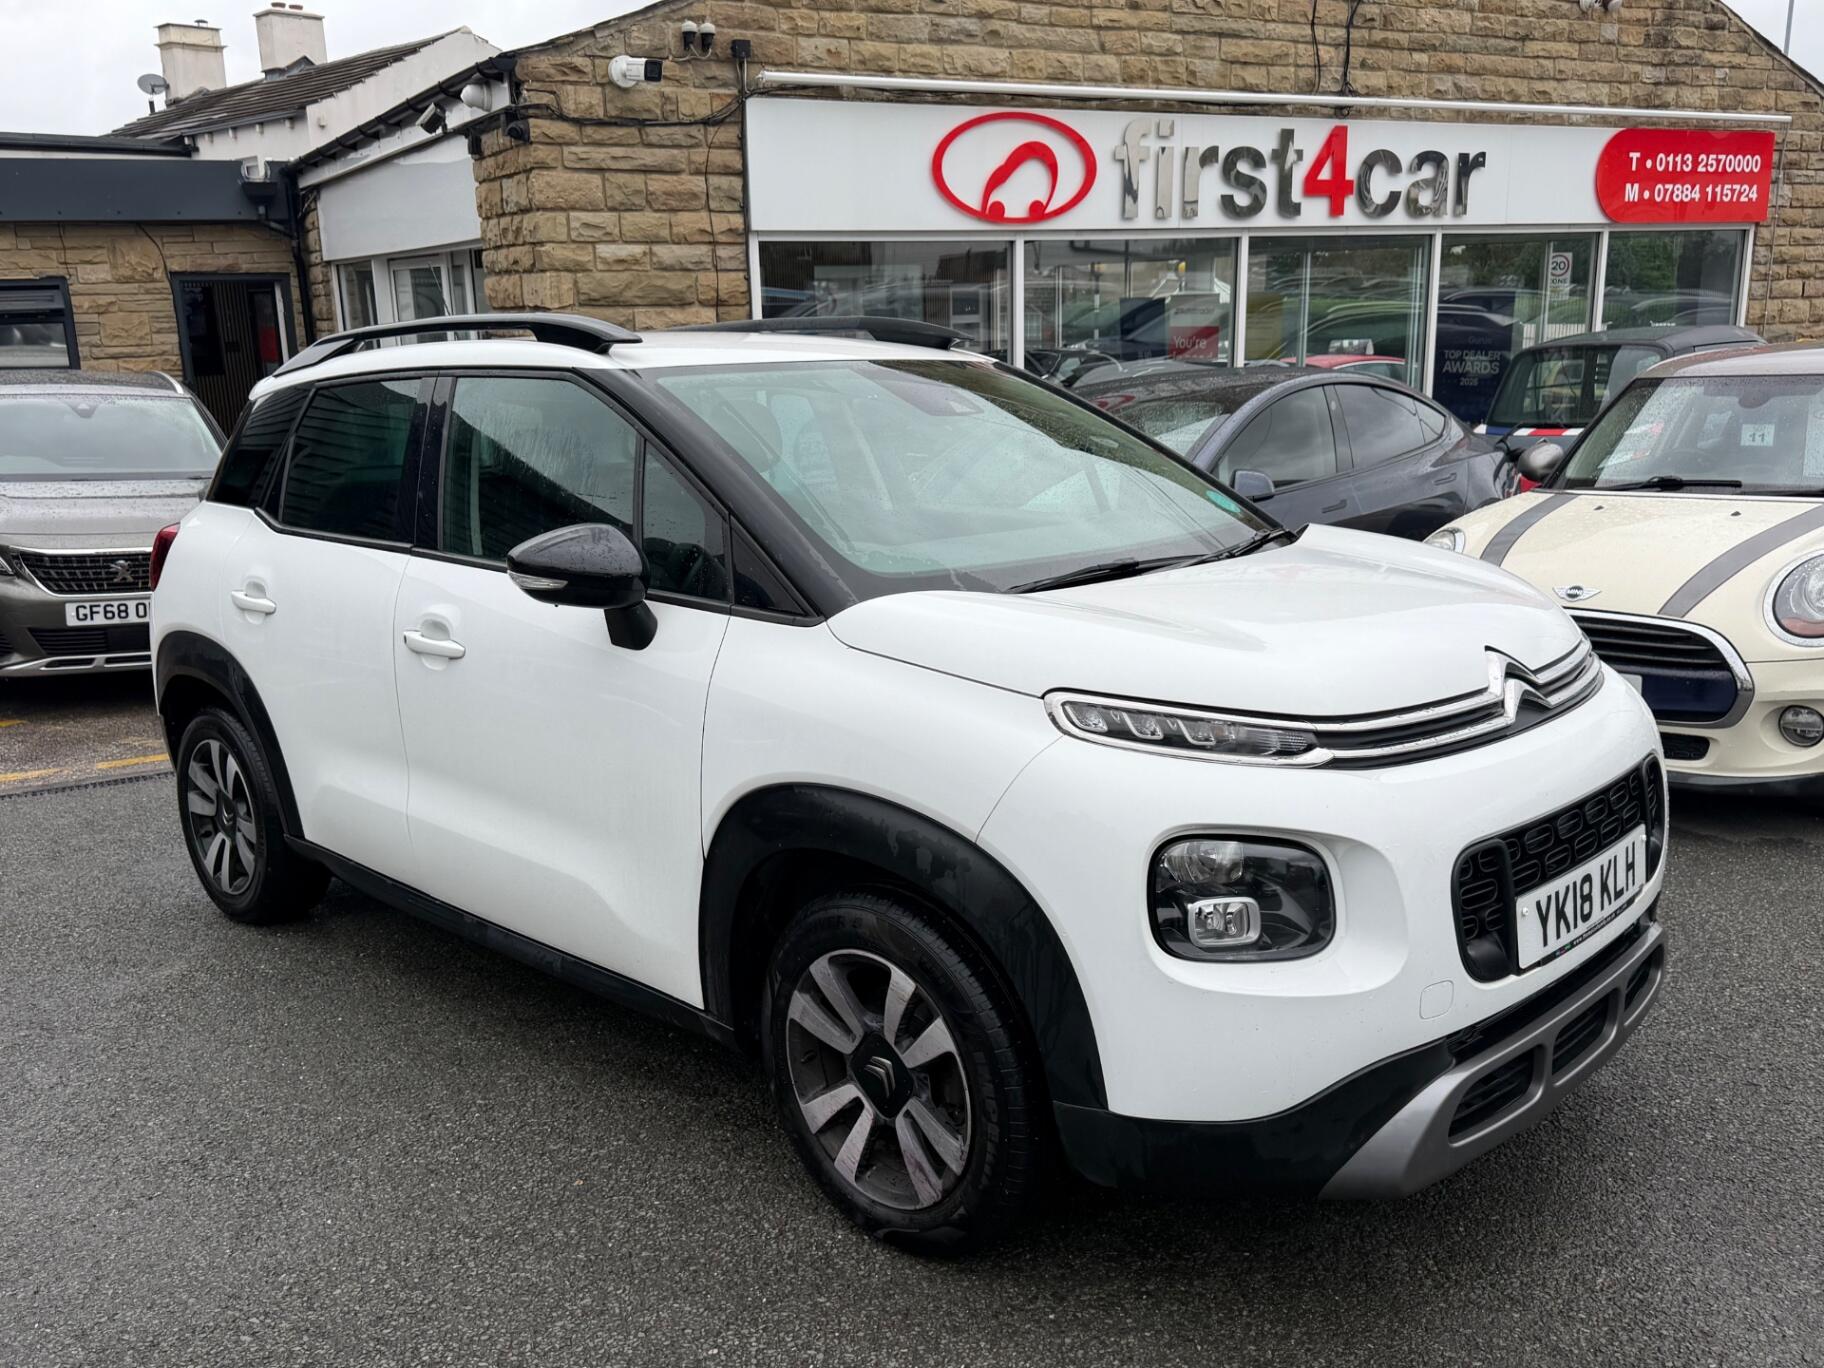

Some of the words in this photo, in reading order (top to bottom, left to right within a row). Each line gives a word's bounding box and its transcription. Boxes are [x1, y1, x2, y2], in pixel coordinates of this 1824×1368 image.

[1114, 119, 1487, 220] first4car
[1629, 152, 1641, 172] T
[1656, 153, 1692, 172] 0113
[1697, 154, 1761, 173] 2570000
[1625, 183, 1639, 202] M
[1654, 183, 1700, 202] 07884
[1705, 184, 1758, 202] 115724
[1174, 336, 1207, 349] You're
[1444, 350, 1462, 360] TOP
[1462, 350, 1501, 361] DEALER
[1442, 361, 1500, 374] AWARDS
[75, 603, 129, 622] GF68
[1535, 872, 1593, 948] YK18
[1600, 841, 1636, 912] KLH
